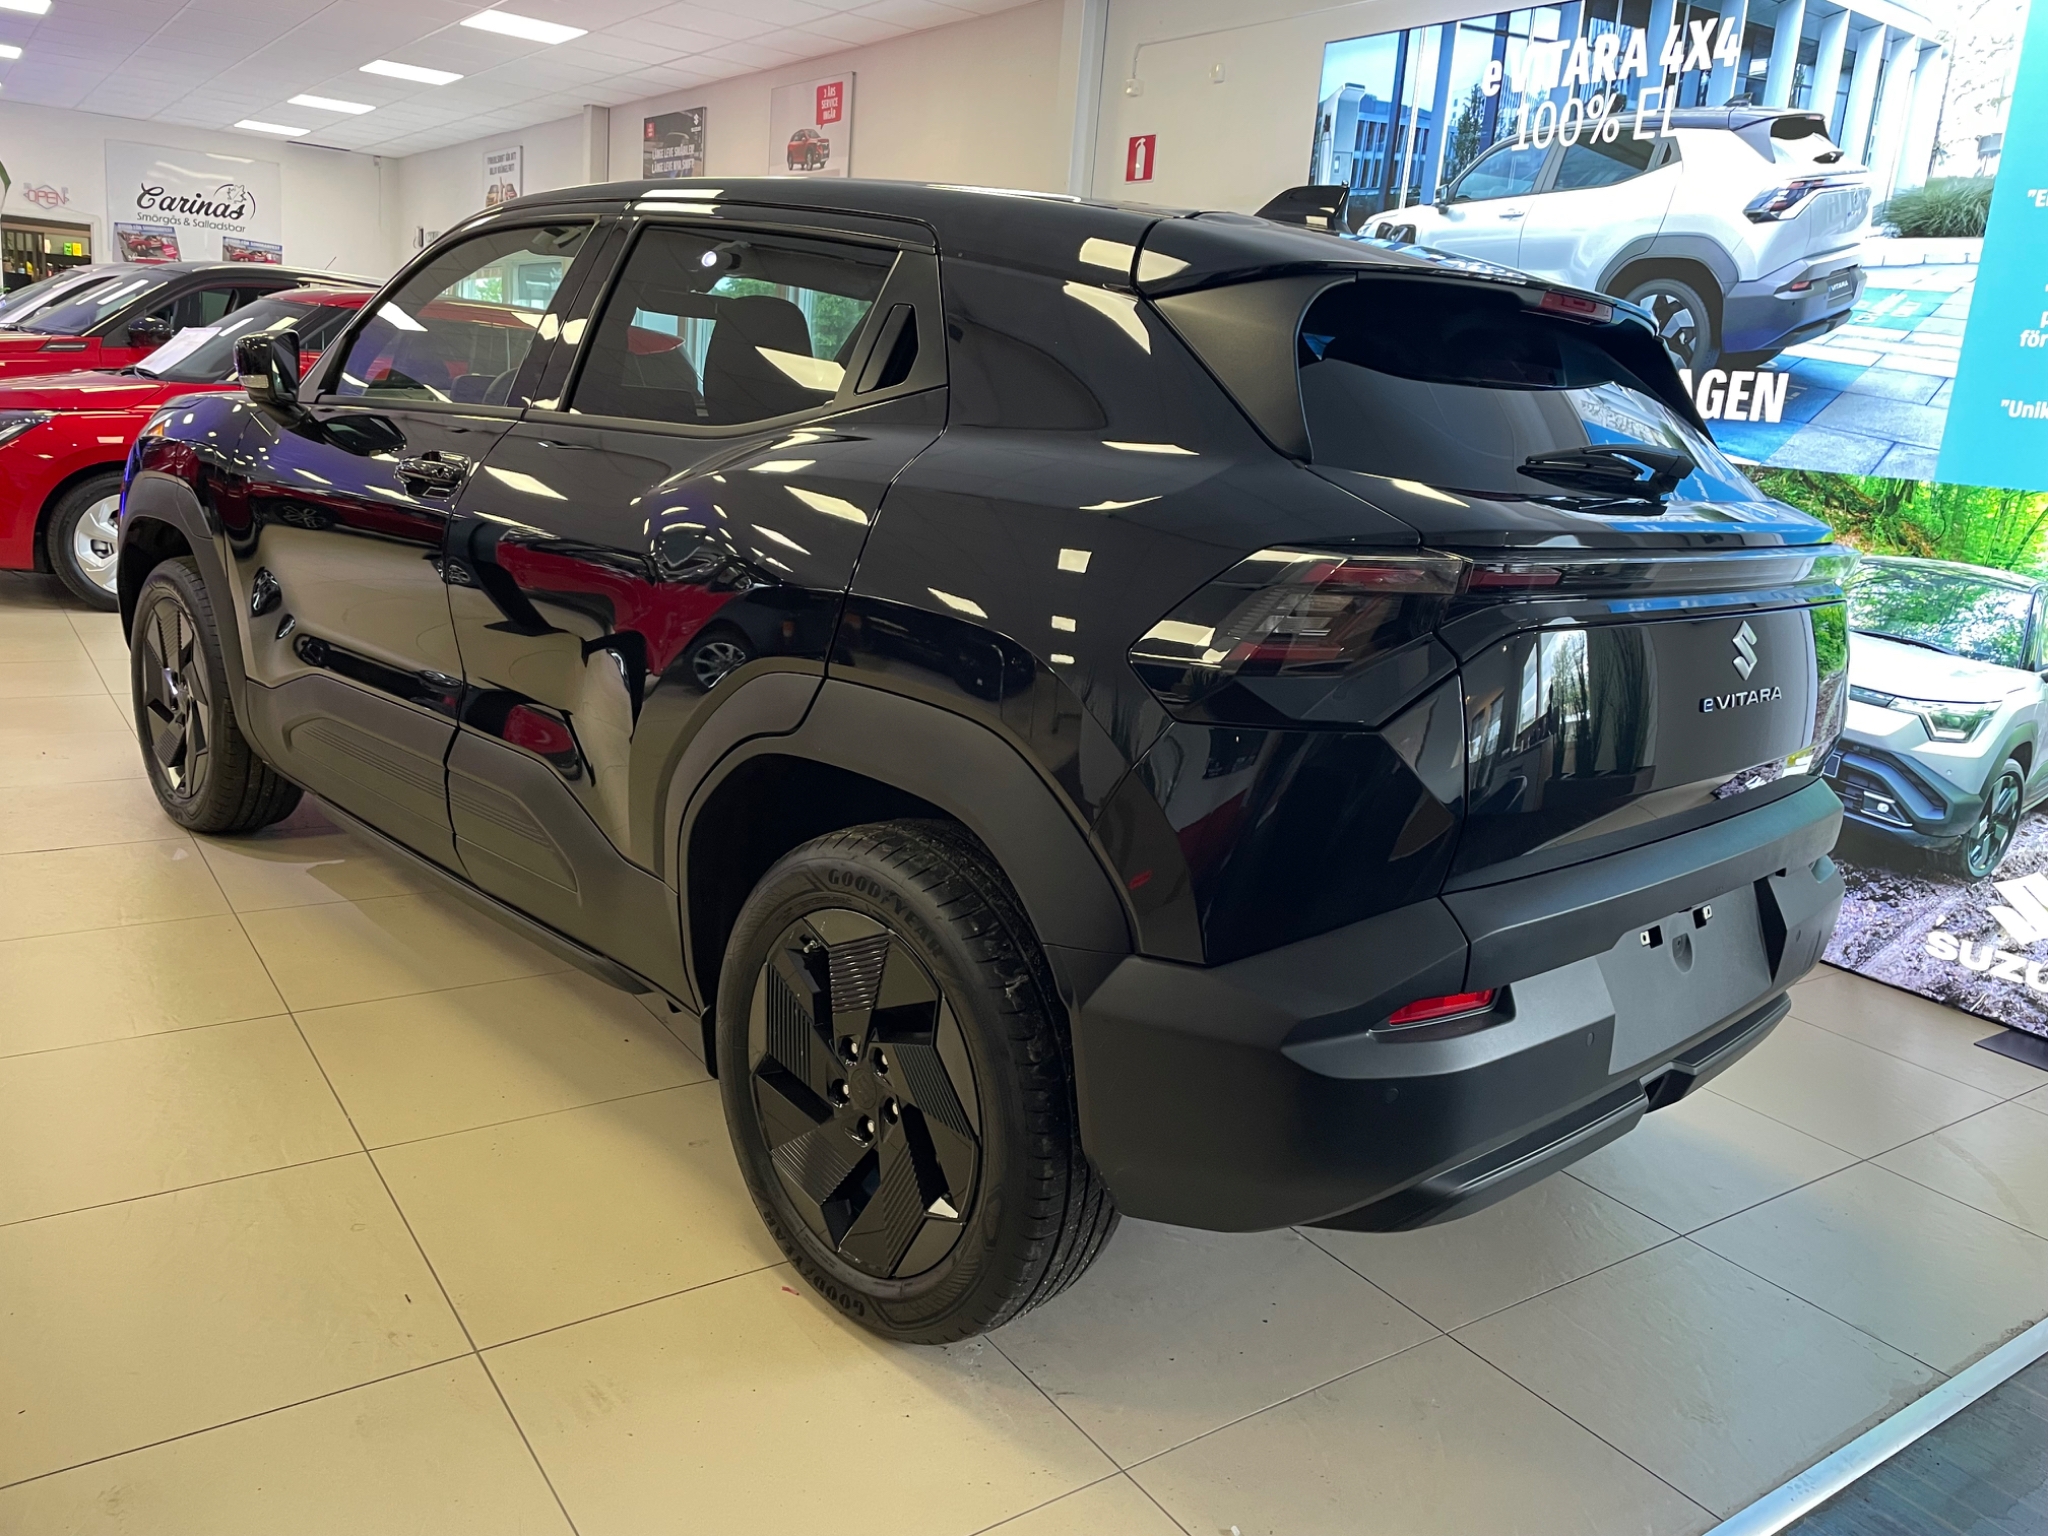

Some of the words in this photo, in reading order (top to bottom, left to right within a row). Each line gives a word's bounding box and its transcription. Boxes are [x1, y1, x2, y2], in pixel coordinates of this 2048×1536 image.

[1510, 28, 1649, 93] VITARA
[1660, 17, 1740, 74] 4X4
[821, 97, 838, 110] SERVICE
[1511, 93, 1620, 151] 100%
[1632, 85, 1676, 141] EL
[27, 188, 66, 205] OPEN
[136, 182, 246, 220] Carinas
[136, 211, 182, 226] Smörgås
[183, 218, 191, 226] &
[193, 218, 246, 233] Salladsbar
[828, 868, 945, 959] GOODYEAR
